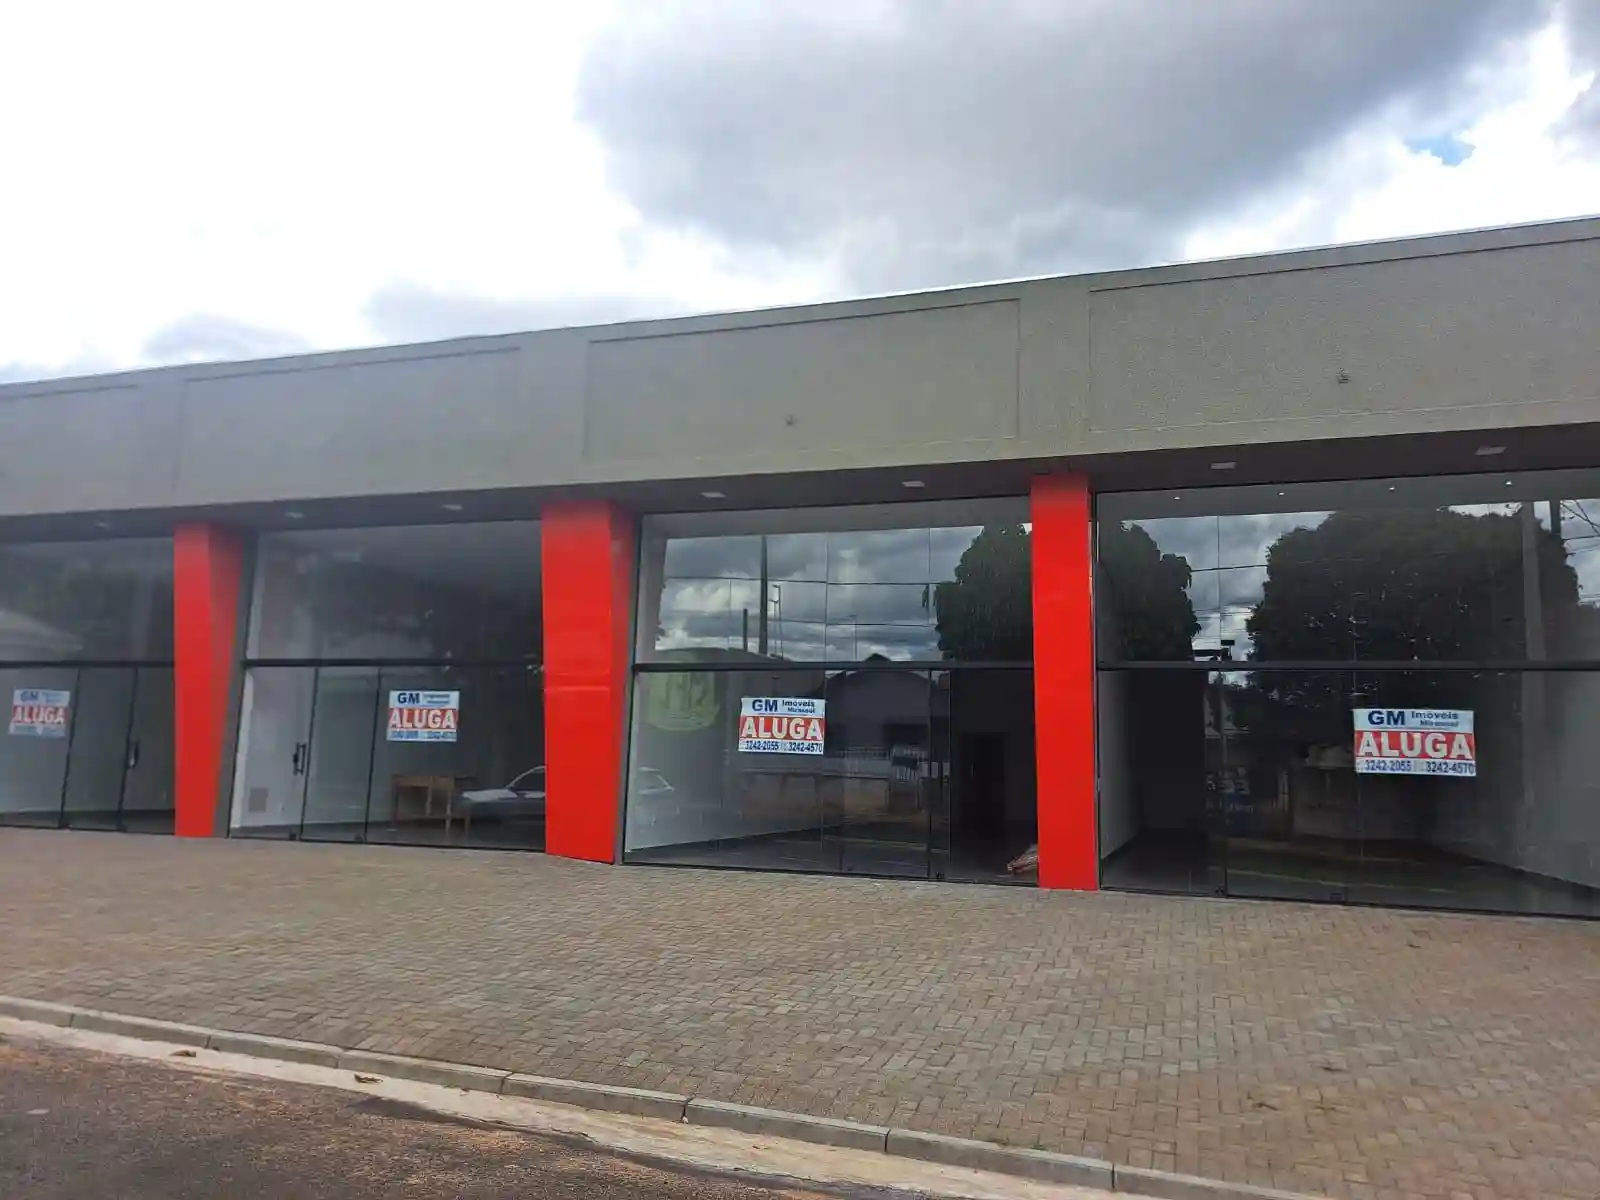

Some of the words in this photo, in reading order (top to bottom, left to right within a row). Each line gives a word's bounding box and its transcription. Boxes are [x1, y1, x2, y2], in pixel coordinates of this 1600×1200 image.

[397, 692, 421, 704] GM
[752, 699, 778, 712] GM
[12, 705, 65, 724] ALUGA
[389, 708, 455, 729] ALUGA
[1368, 710, 1406, 726] GM
[741, 716, 823, 740] ALUGA
[745, 740, 779, 751] 3242-2055
[788, 741, 823, 753] 3242-4570
[1358, 731, 1473, 760] ALUGA
[1365, 760, 1412, 772] 3242-2055
[1427, 760, 1475, 774] 3242-4570
